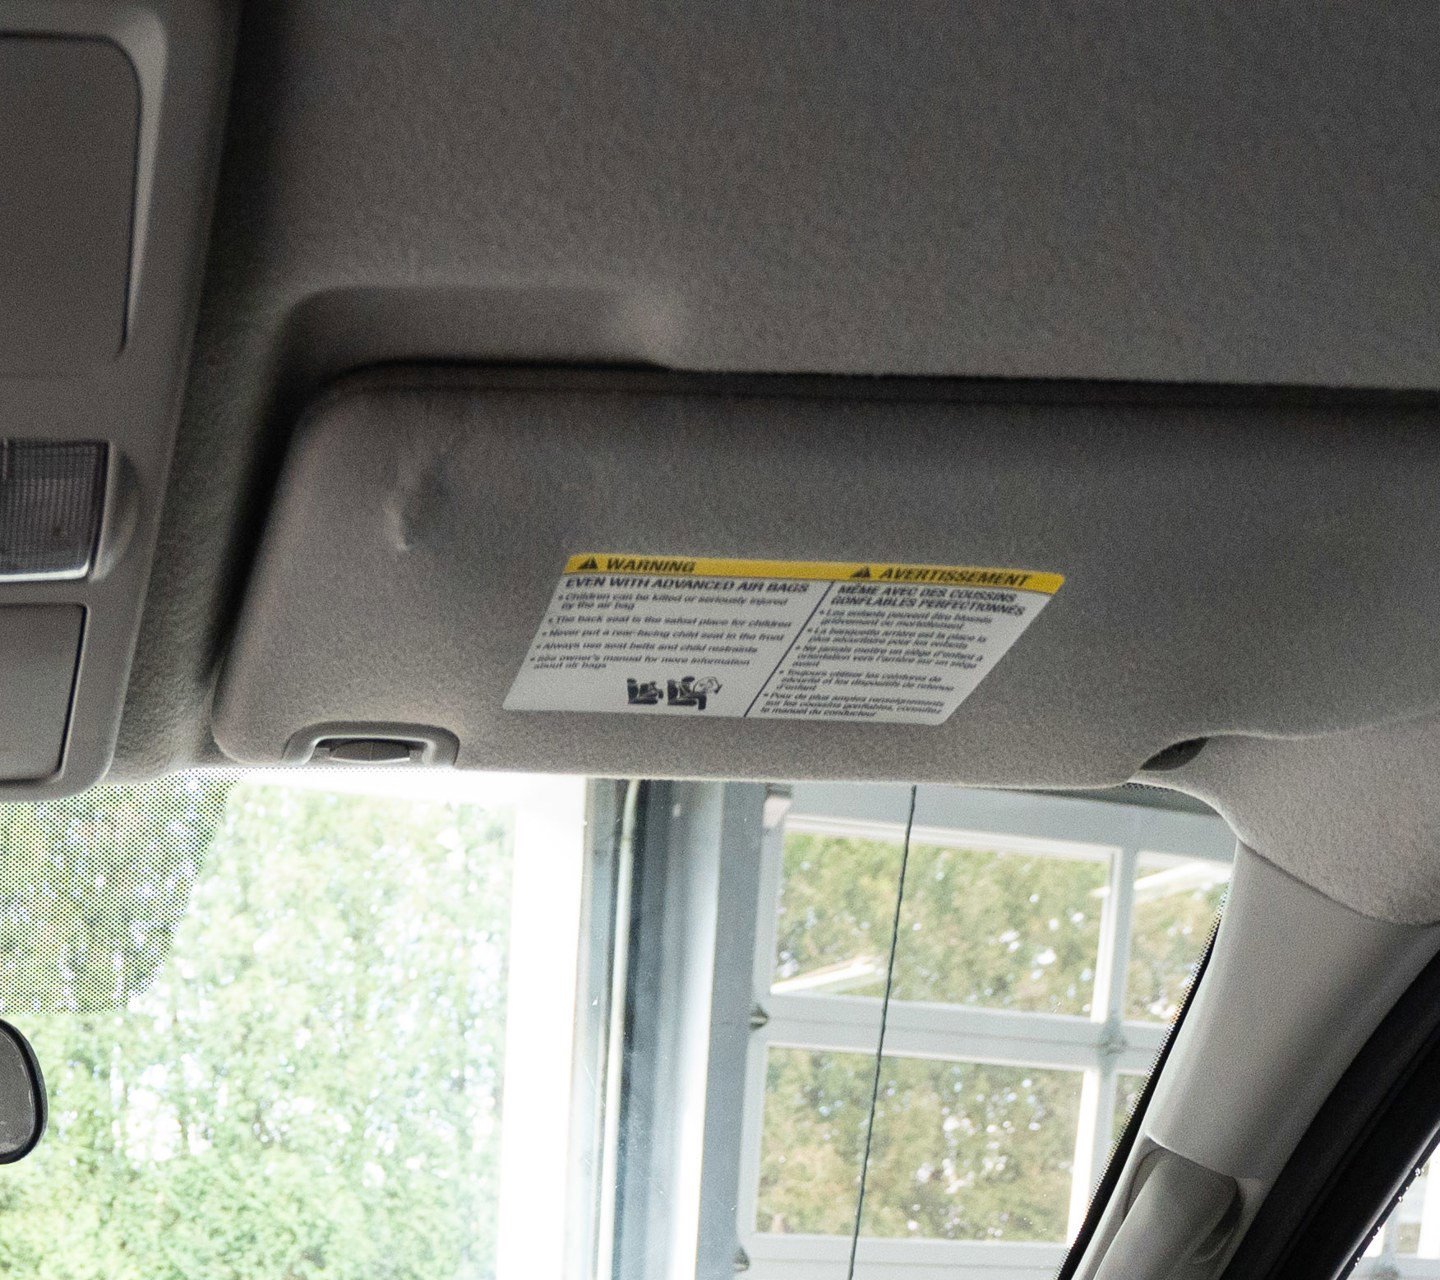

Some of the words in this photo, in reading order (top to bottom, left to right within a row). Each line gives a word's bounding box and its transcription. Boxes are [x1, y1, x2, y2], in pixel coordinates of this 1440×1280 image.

[607, 558, 695, 572] WARNING
[879, 567, 1032, 586] AVERTISSEMENT
[566, 577, 606, 587] EVEN
[610, 578, 649, 587] WITH
[651, 578, 734, 590] ADVANCED
[738, 582, 764, 591] AIR
[767, 583, 809, 592] BAGS
[882, 587, 918, 596] AVEC
[920, 588, 947, 597] DES
